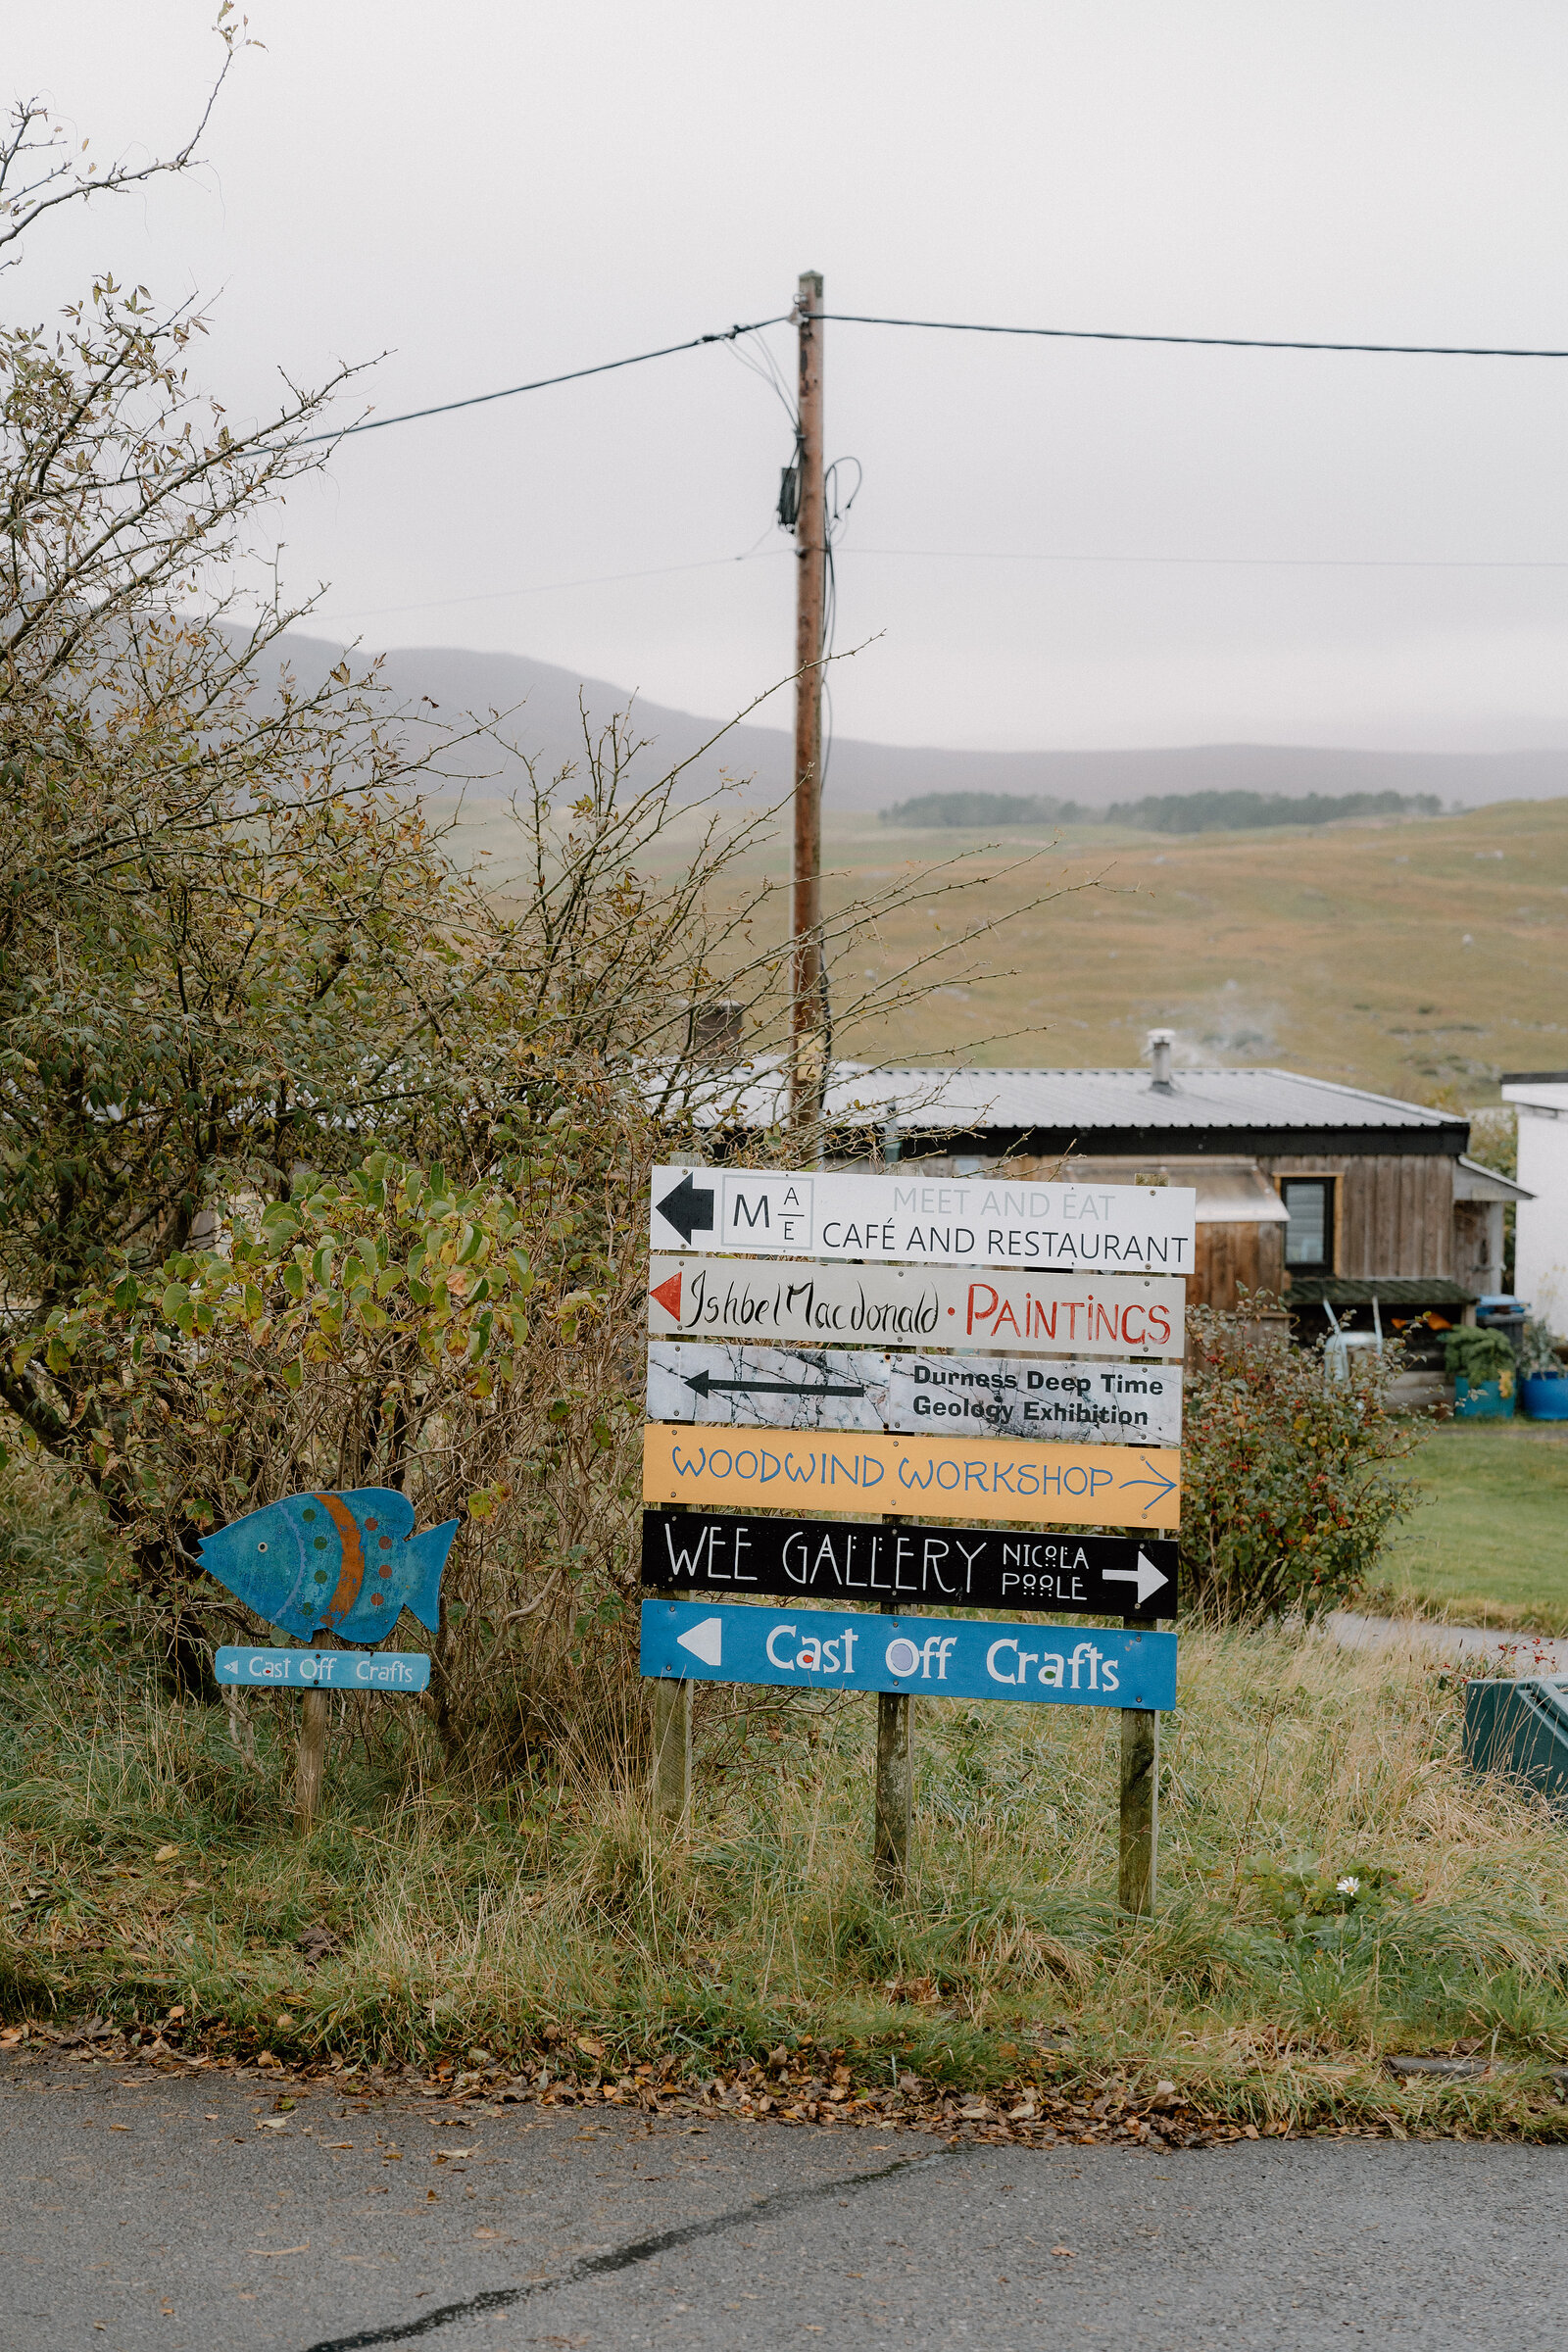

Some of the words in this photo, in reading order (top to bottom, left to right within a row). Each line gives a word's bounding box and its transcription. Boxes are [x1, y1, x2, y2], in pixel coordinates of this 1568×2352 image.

[893, 1186, 971, 1215] MEET
[980, 1190, 1052, 1218] AND
[1062, 1193, 1116, 1221] EAT
[822, 1217, 896, 1251] CAFÉ
[906, 1225, 976, 1253] AND
[987, 1228, 1189, 1263] RESTAURANT
[912, 1365, 1018, 1391] Durness
[1026, 1370, 1092, 1397] Deep
[1100, 1372, 1164, 1396] Time
[912, 1395, 1013, 1424] Geology
[1023, 1400, 1148, 1426] Exhibition
[671, 1446, 885, 1488] WOODWIND
[898, 1457, 1113, 1497] WORKSHOP
[664, 1522, 759, 1581] WEE
[782, 1531, 988, 1593] GALLERY
[1003, 1543, 1090, 1570] NICOLA
[1002, 1572, 1088, 1601] POOLE
[248, 1655, 291, 1680] Cast
[299, 1656, 337, 1681] Off
[356, 1660, 414, 1684] Crafts
[765, 1624, 858, 1675] Cast
[885, 1636, 957, 1680] Off
[986, 1638, 1120, 1693] Crafts
